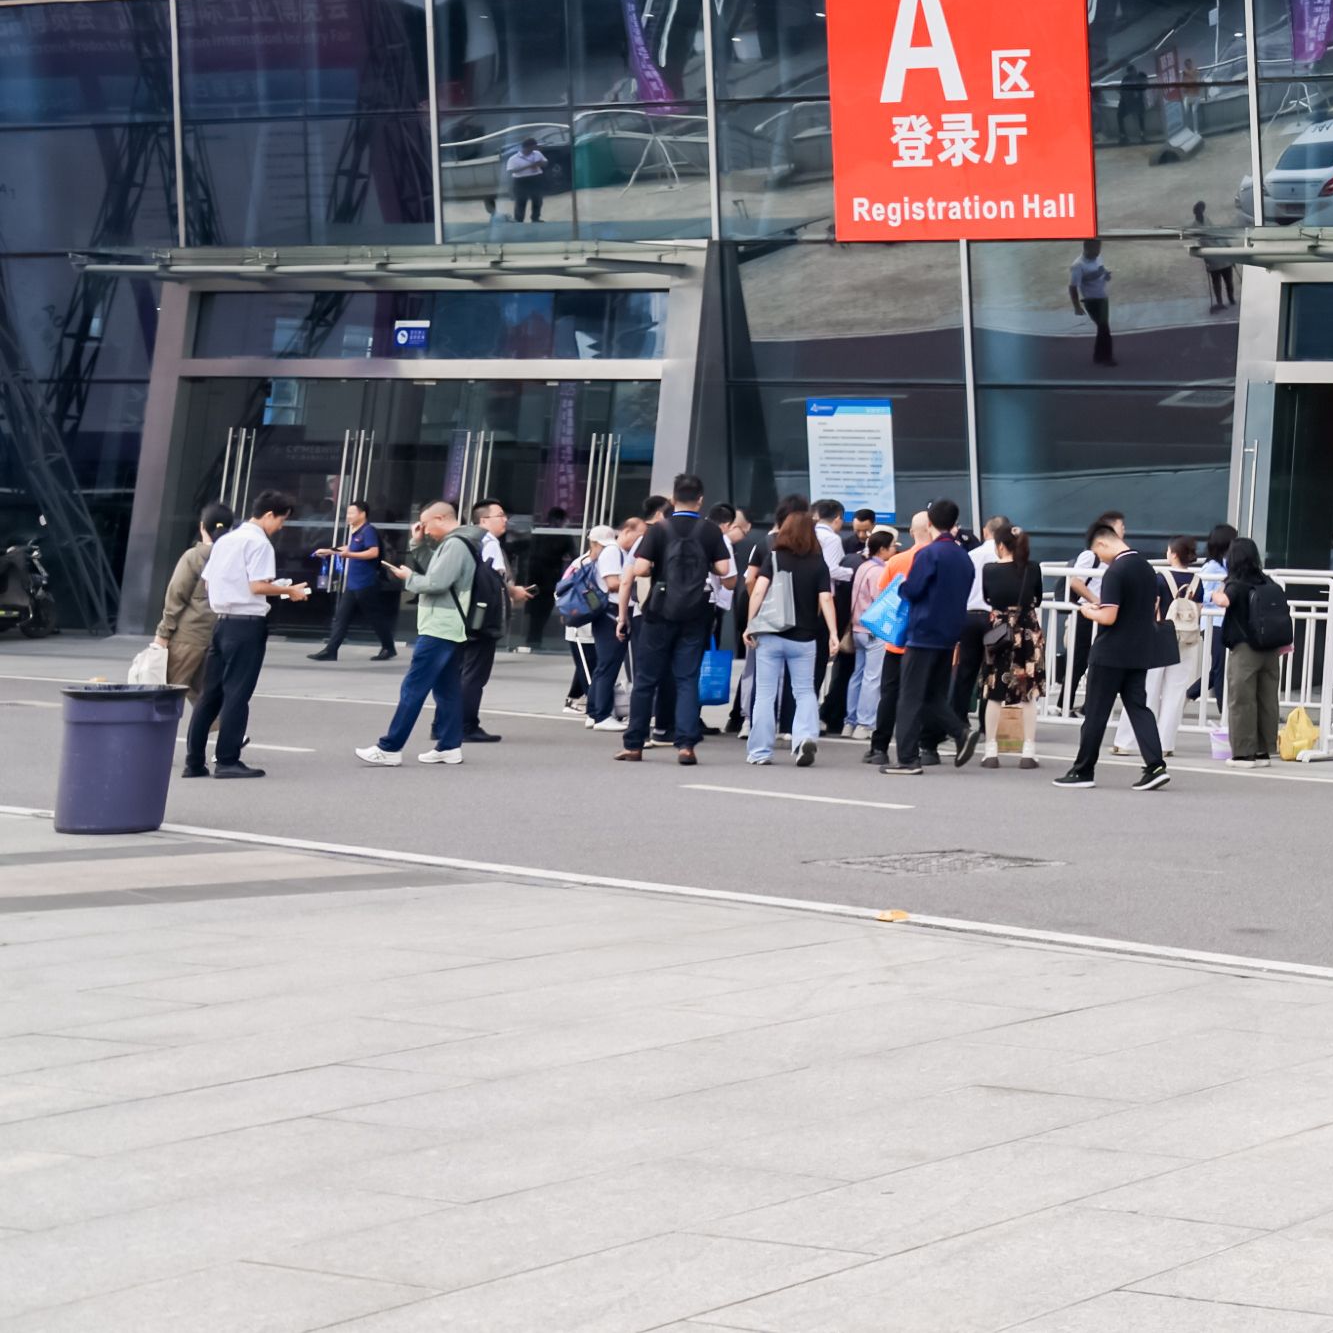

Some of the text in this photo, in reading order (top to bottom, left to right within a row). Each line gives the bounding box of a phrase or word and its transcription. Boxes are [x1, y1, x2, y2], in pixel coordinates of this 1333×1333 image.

[890, 113, 1028, 168] 登录厅
[852, 193, 1076, 227] Registration Hall
